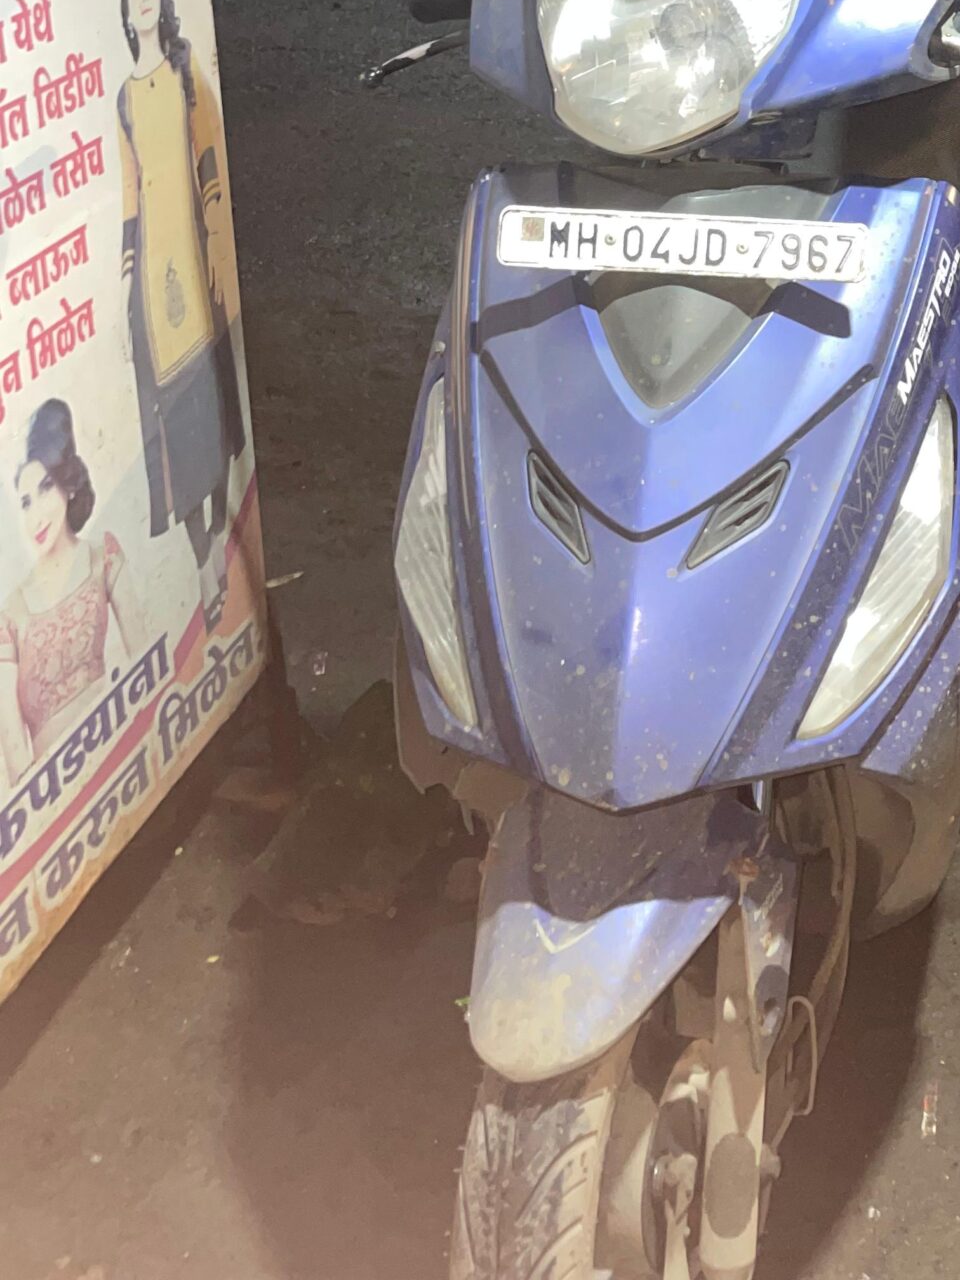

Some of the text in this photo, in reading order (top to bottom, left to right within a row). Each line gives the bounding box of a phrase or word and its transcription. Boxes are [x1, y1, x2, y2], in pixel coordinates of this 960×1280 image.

[33, 52, 105, 130] बिडींग
[50, 130, 105, 199] तसेच
[26, 296, 96, 381] मिळेल
[897, 249, 951, 406] MAESTRO
